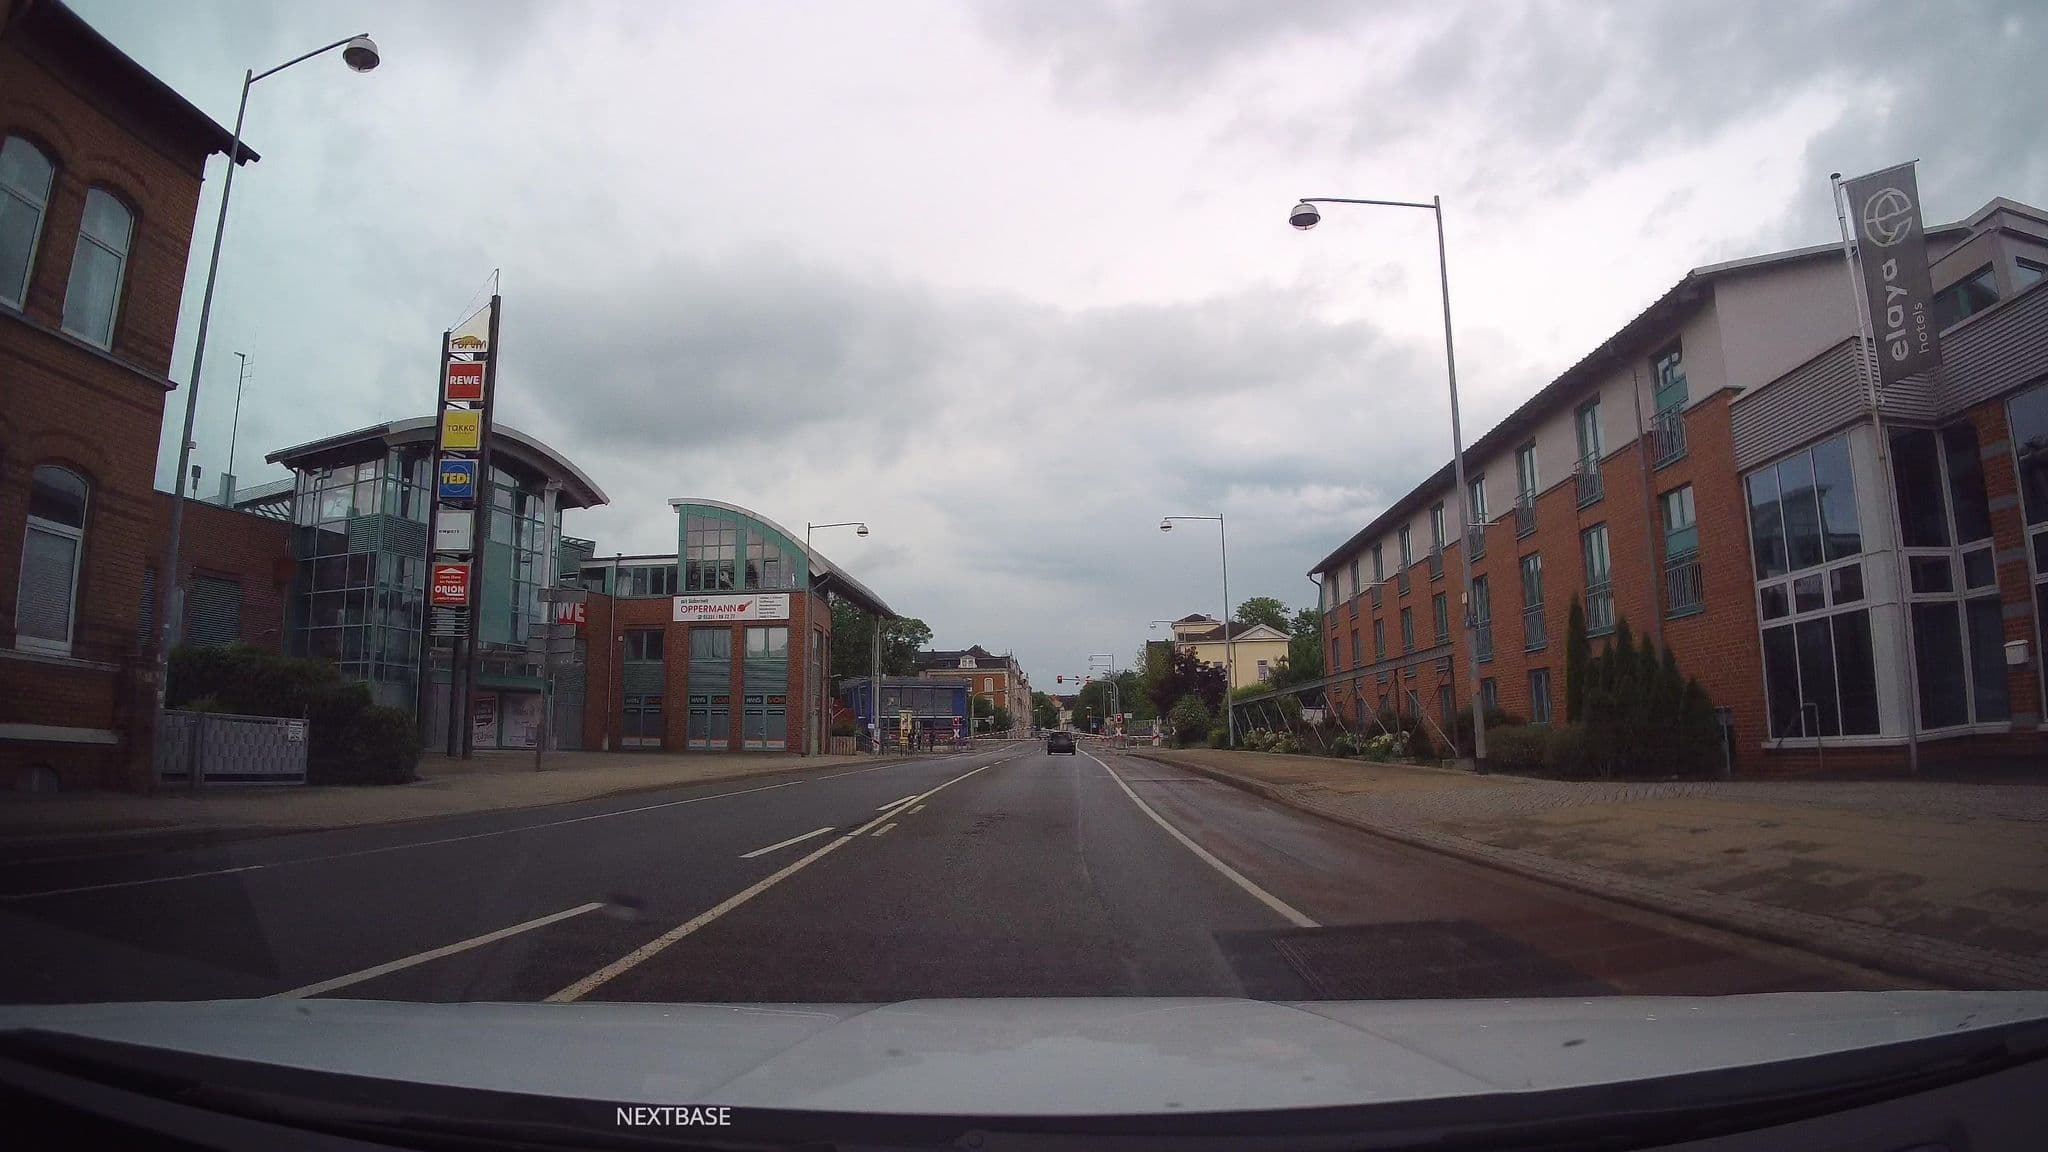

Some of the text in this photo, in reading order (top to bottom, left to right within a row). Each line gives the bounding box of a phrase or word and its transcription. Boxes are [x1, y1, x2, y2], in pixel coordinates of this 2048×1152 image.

[1882, 258, 1909, 361] elaya
[1913, 302, 1930, 354] hotels
[450, 375, 480, 385] REWE
[435, 585, 465, 597] ORION
[555, 602, 585, 623] WE
[681, 604, 737, 614] OPPERMANN
